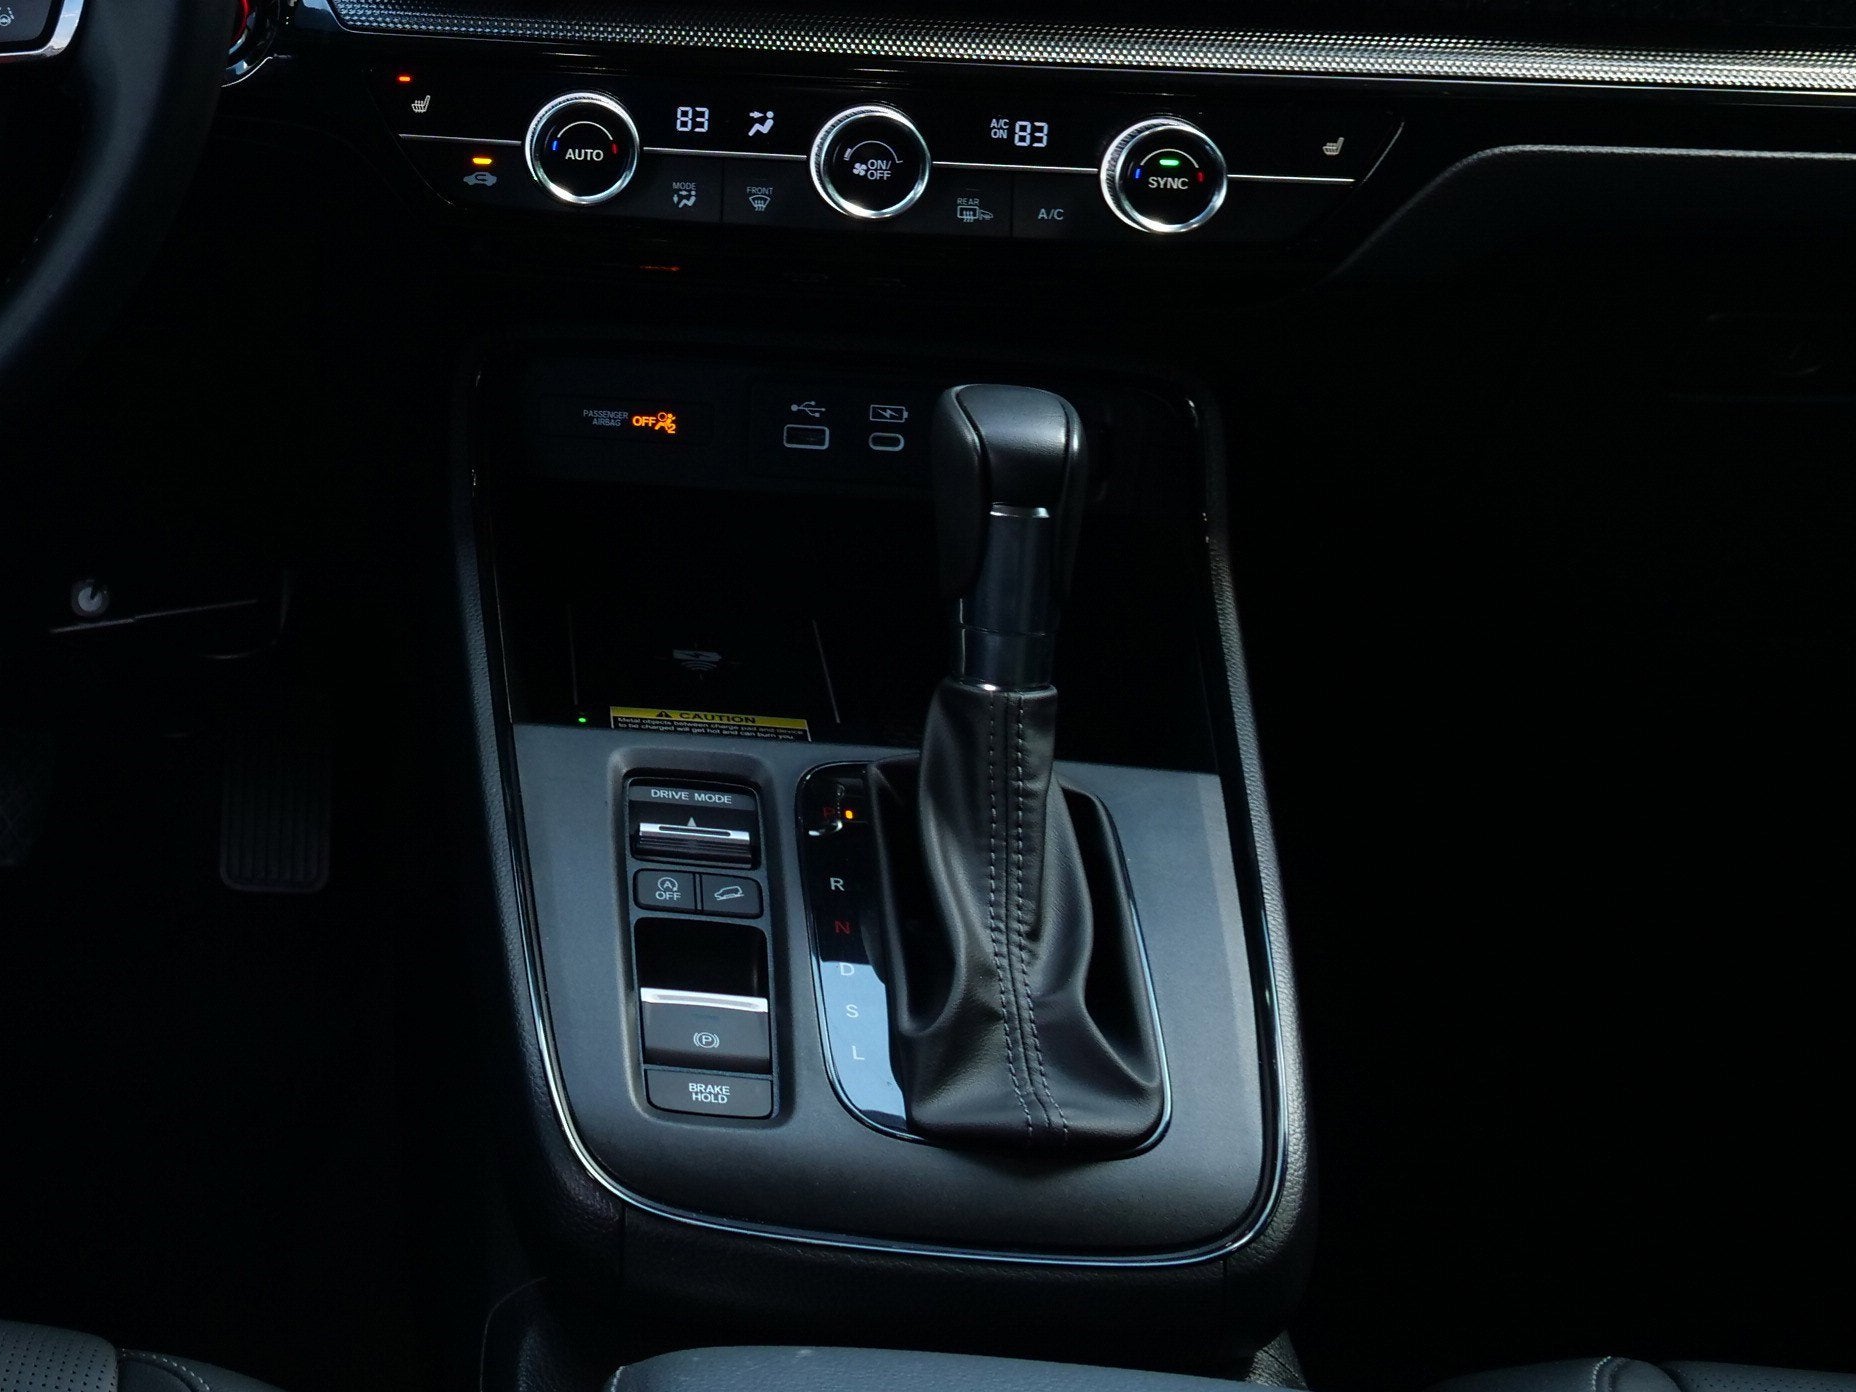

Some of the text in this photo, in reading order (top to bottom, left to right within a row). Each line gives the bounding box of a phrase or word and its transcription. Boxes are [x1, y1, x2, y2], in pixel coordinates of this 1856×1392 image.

[675, 105, 710, 133] 83
[990, 119, 1009, 129] A/C
[991, 129, 1008, 140] ON
[1014, 120, 1049, 148] 83
[564, 148, 604, 162] AUTO
[867, 170, 892, 181] OFF
[672, 181, 697, 190] MODE
[1148, 176, 1189, 190] SYNC
[746, 186, 774, 195] FRONT
[957, 197, 980, 206] REAR
[1037, 208, 1064, 221] A/C
[583, 409, 629, 419] PASSENGER
[632, 415, 657, 427] OFF
[679, 712, 756, 724] CAUTION
[650, 788, 732, 804] DRIVE MODE
[830, 877, 845, 891] R
[655, 890, 682, 901] OFF
[833, 919, 852, 935] N
[839, 962, 855, 976] D
[846, 1004, 859, 1018] S
[852, 1045, 865, 1061] L
[688, 1082, 731, 1095] BRAKE
[691, 1092, 728, 1104] HOLD
